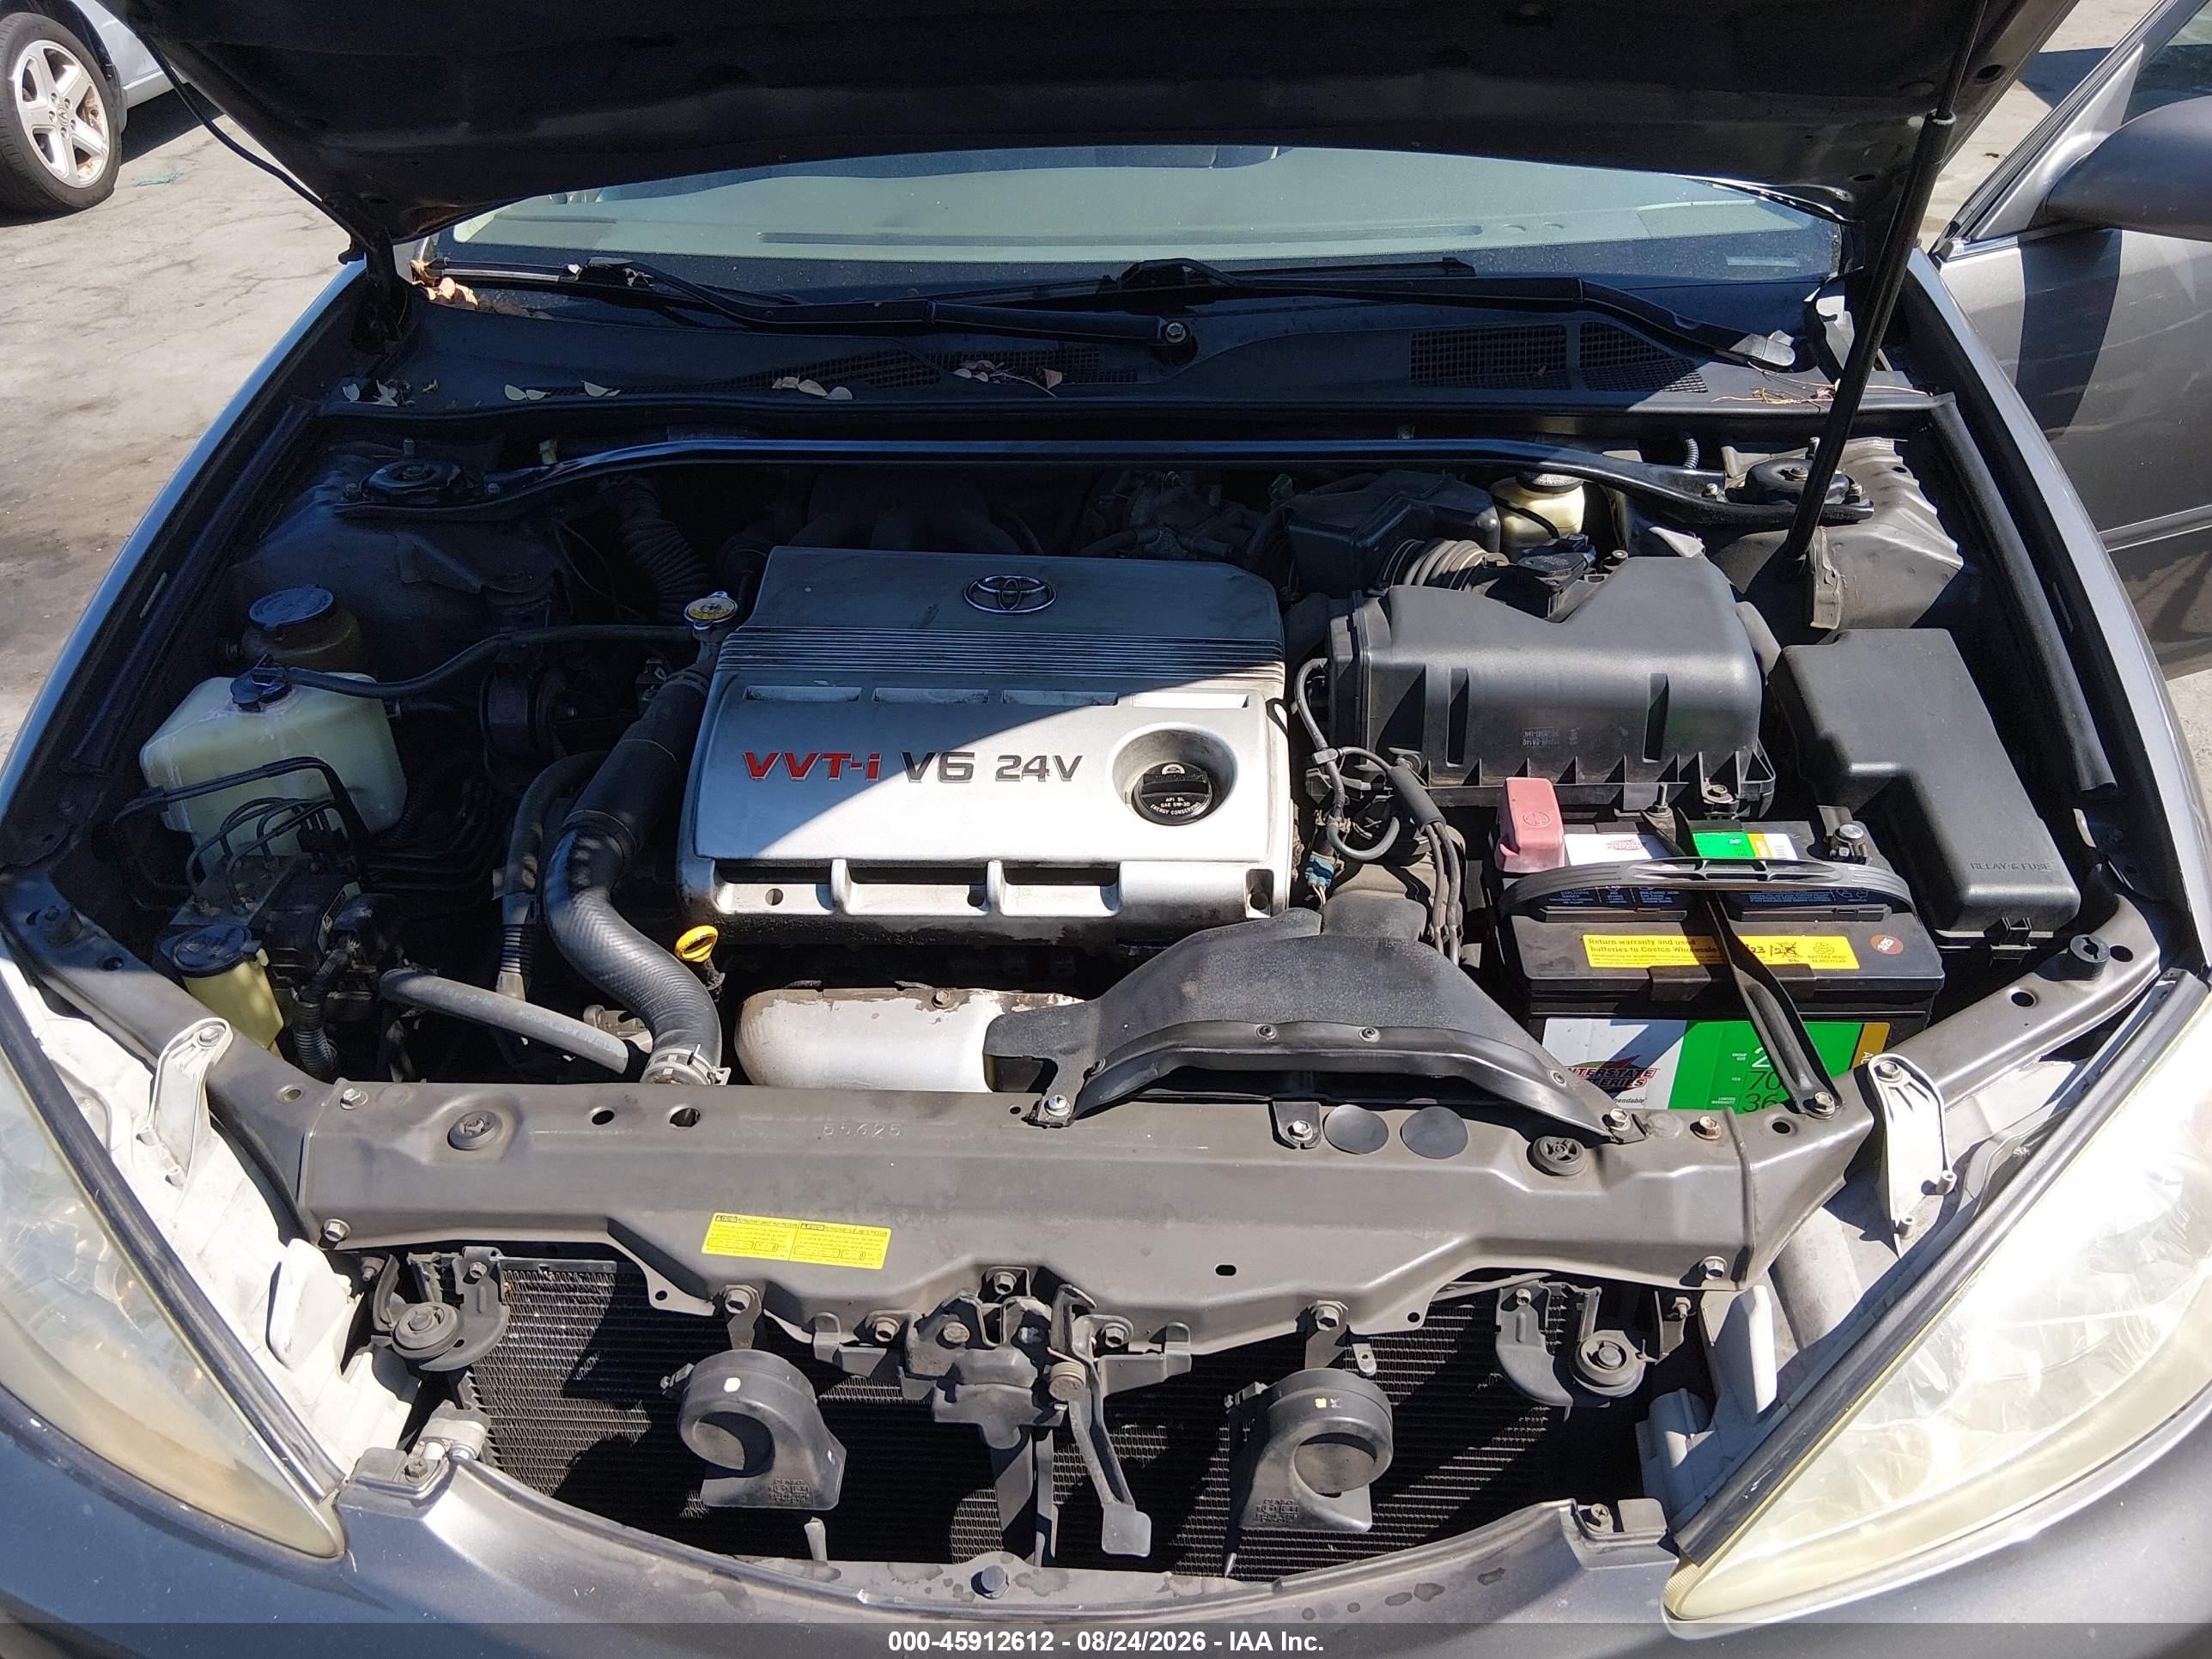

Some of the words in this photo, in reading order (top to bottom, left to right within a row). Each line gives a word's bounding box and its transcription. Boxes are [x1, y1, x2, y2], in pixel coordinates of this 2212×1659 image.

[744, 752, 882, 782] VVT-i
[901, 751, 975, 784] V6
[995, 755, 1084, 782] 24V
[1150, 804, 1170, 815] ENERGY
[1970, 862, 2007, 871] RELAY
[2021, 862, 2051, 872] FUSE
[1752, 1047, 1771, 1067] 2
[1567, 1067, 1656, 1079] NTERSTATE
[1592, 1078, 1645, 1087] TERIES
[1749, 1070, 1781, 1091] 70
